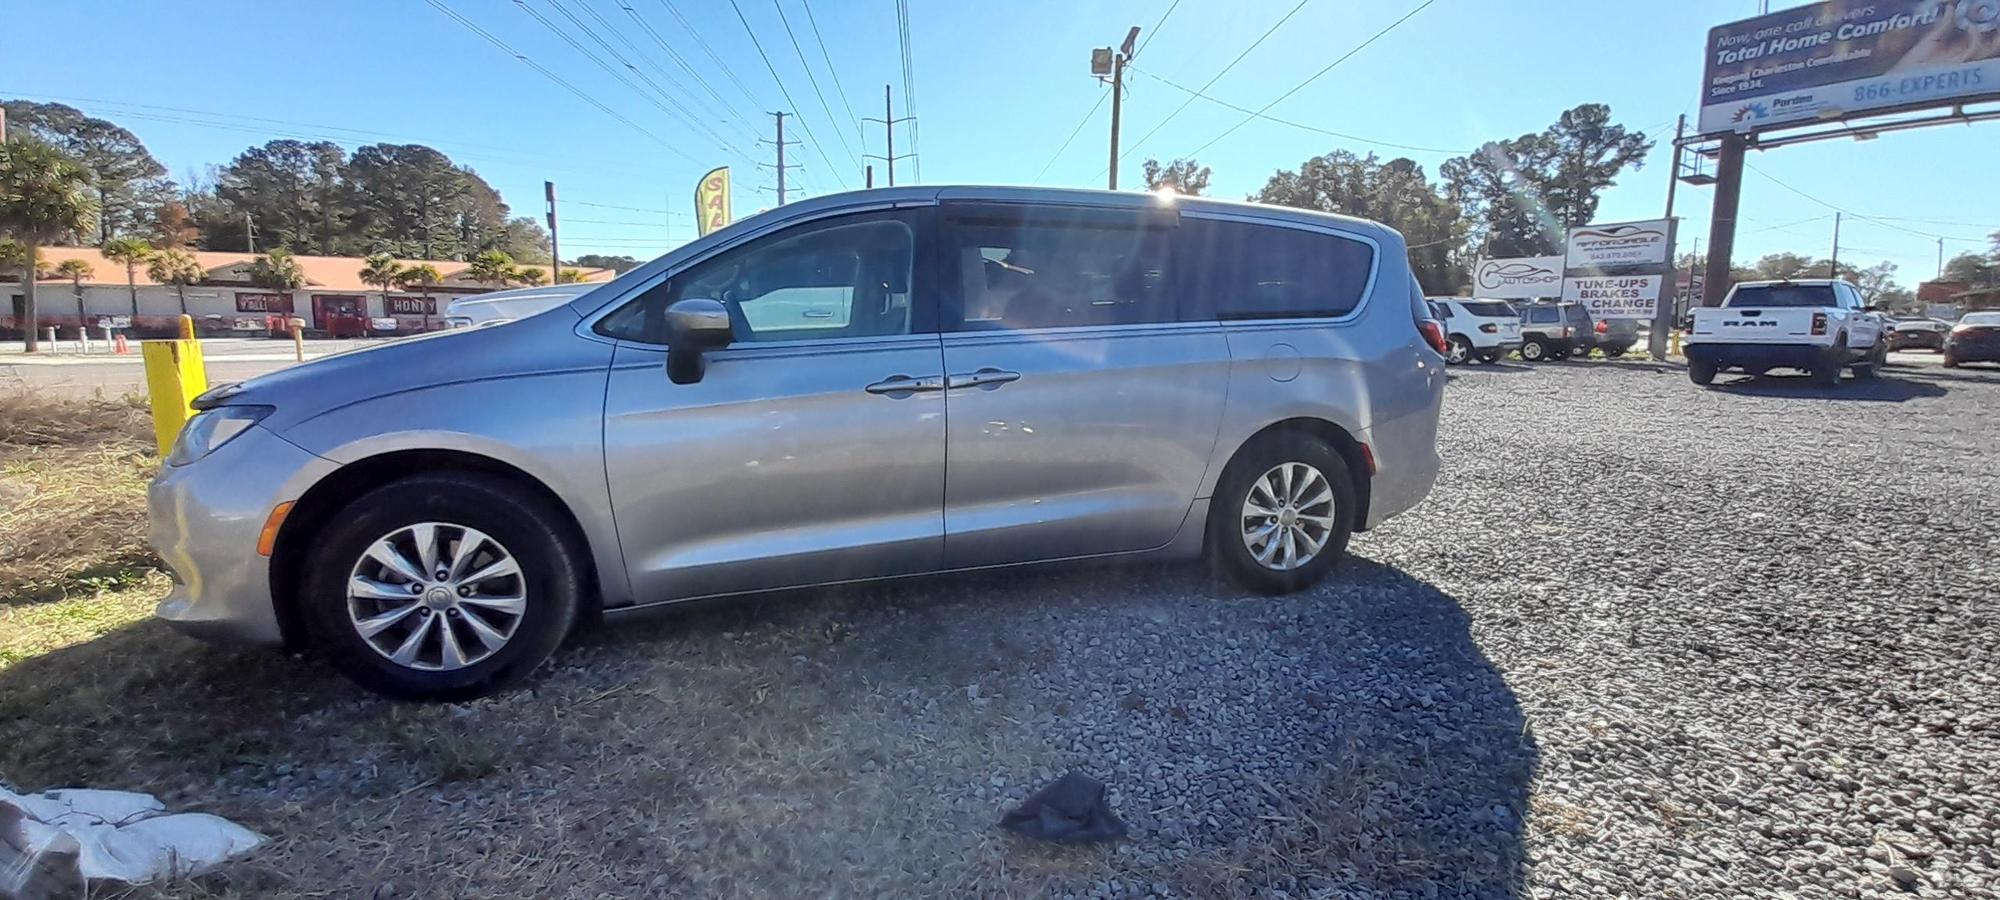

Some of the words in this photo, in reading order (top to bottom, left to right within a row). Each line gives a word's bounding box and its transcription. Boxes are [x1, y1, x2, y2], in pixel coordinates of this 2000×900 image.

[1753, 25, 1782, 39] one
[1785, 16, 1813, 33] call
[1716, 41, 1766, 65] Total
[1768, 30, 1832, 55] Home
[1711, 85, 1736, 97] Since
[1854, 68, 1983, 102] 866-EXPERTS
[1574, 278, 1649, 290] TUNE-UPS
[1580, 289, 1640, 299] BRAKES
[1591, 298, 1655, 309] CHANGE
